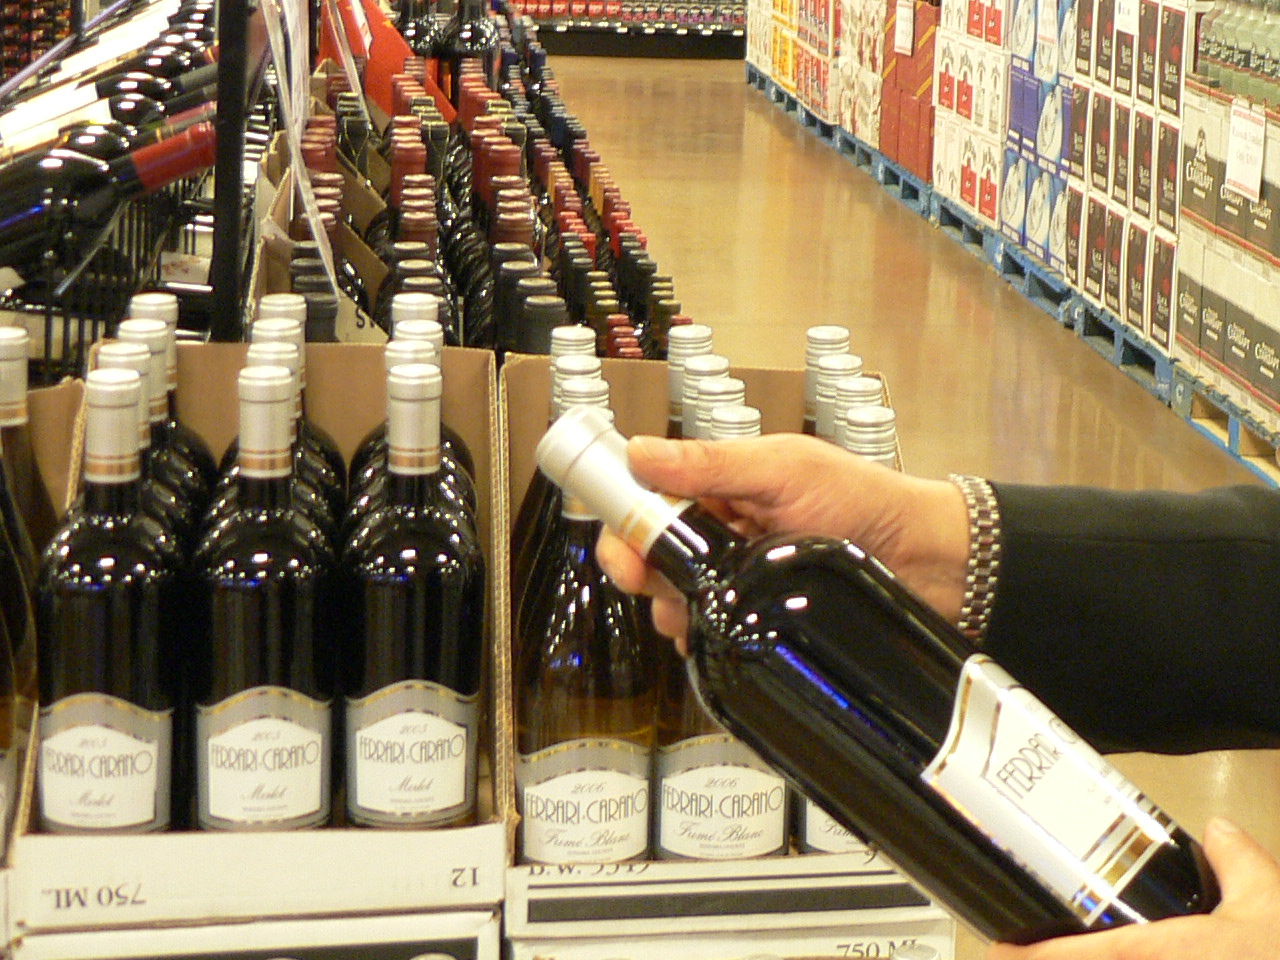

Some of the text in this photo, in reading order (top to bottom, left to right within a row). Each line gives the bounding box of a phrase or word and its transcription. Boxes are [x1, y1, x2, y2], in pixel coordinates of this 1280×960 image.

[262, 740, 320, 772] CARANO
[409, 734, 465, 764] CARANO
[525, 787, 648, 825] FERRARI CARANO
[662, 783, 784, 819] FERRARI CARANO
[819, 817, 855, 837] Fum
[451, 865, 481, 888] 12
[96, 881, 147, 907] 750
[836, 941, 881, 959] 750
